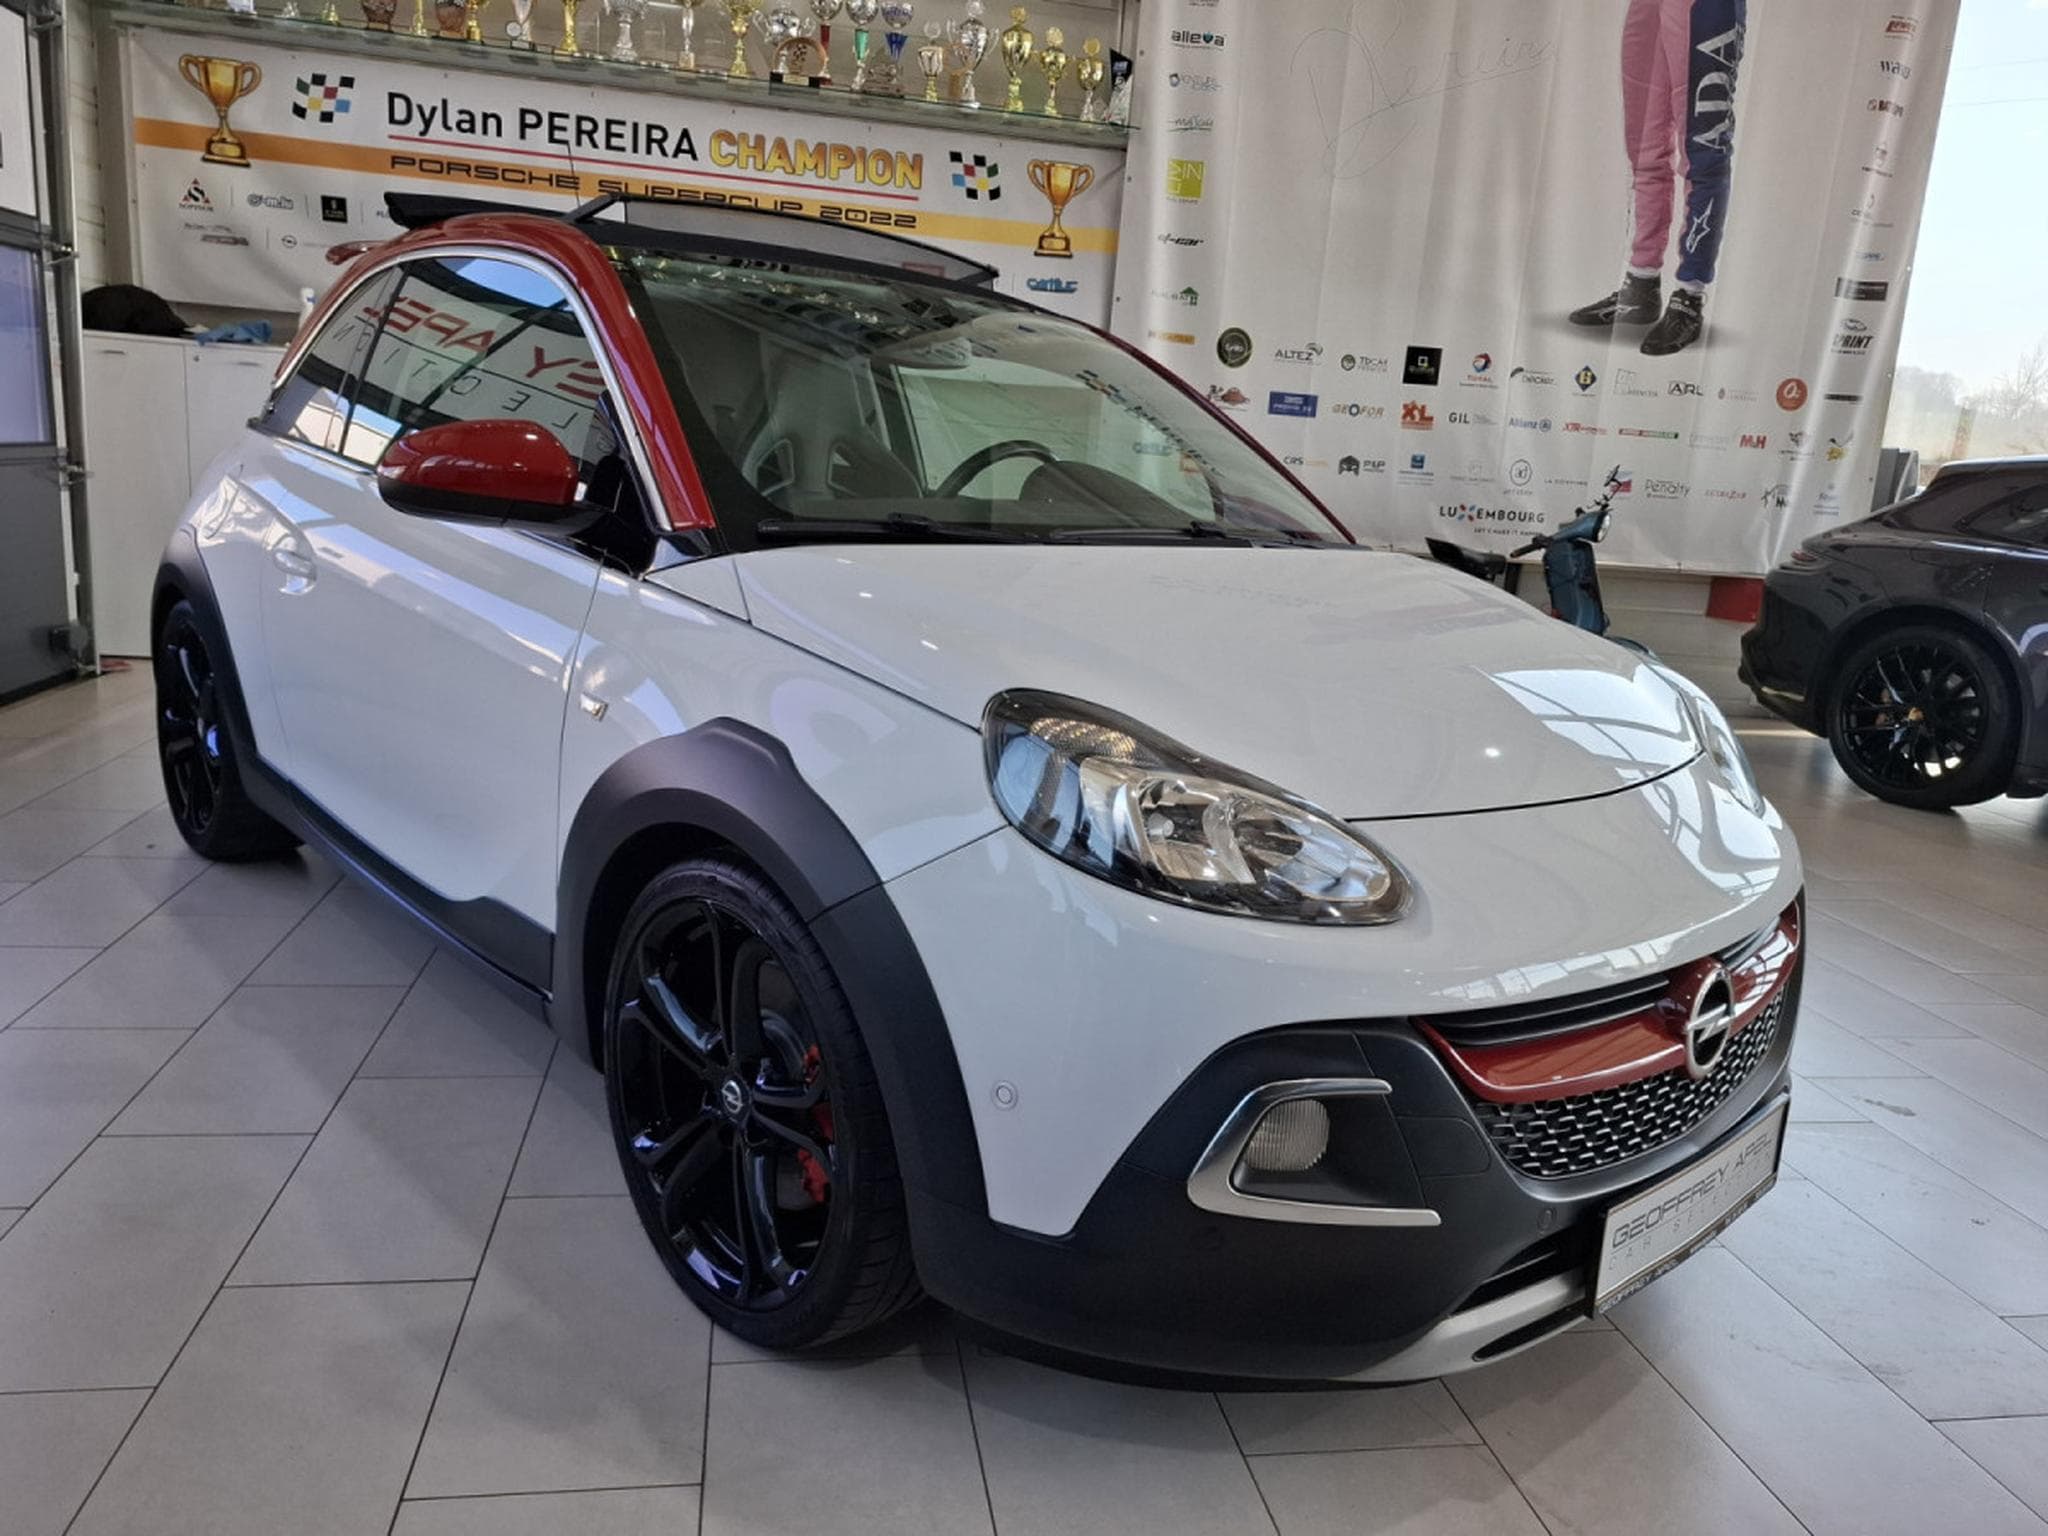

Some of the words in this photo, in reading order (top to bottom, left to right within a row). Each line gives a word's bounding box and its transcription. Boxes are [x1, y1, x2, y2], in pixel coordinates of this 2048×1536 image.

[387, 91, 503, 137] Dylan
[519, 108, 699, 162] PEREIRA
[709, 129, 923, 190] CHAMPION
[390, 155, 581, 190] PORSCHE
[819, 205, 917, 229] 2022
[1275, 348, 1314, 361] ALTEZ
[1448, 411, 1470, 424] GIL
[1612, 1162, 1731, 1249] GEOFFREY
